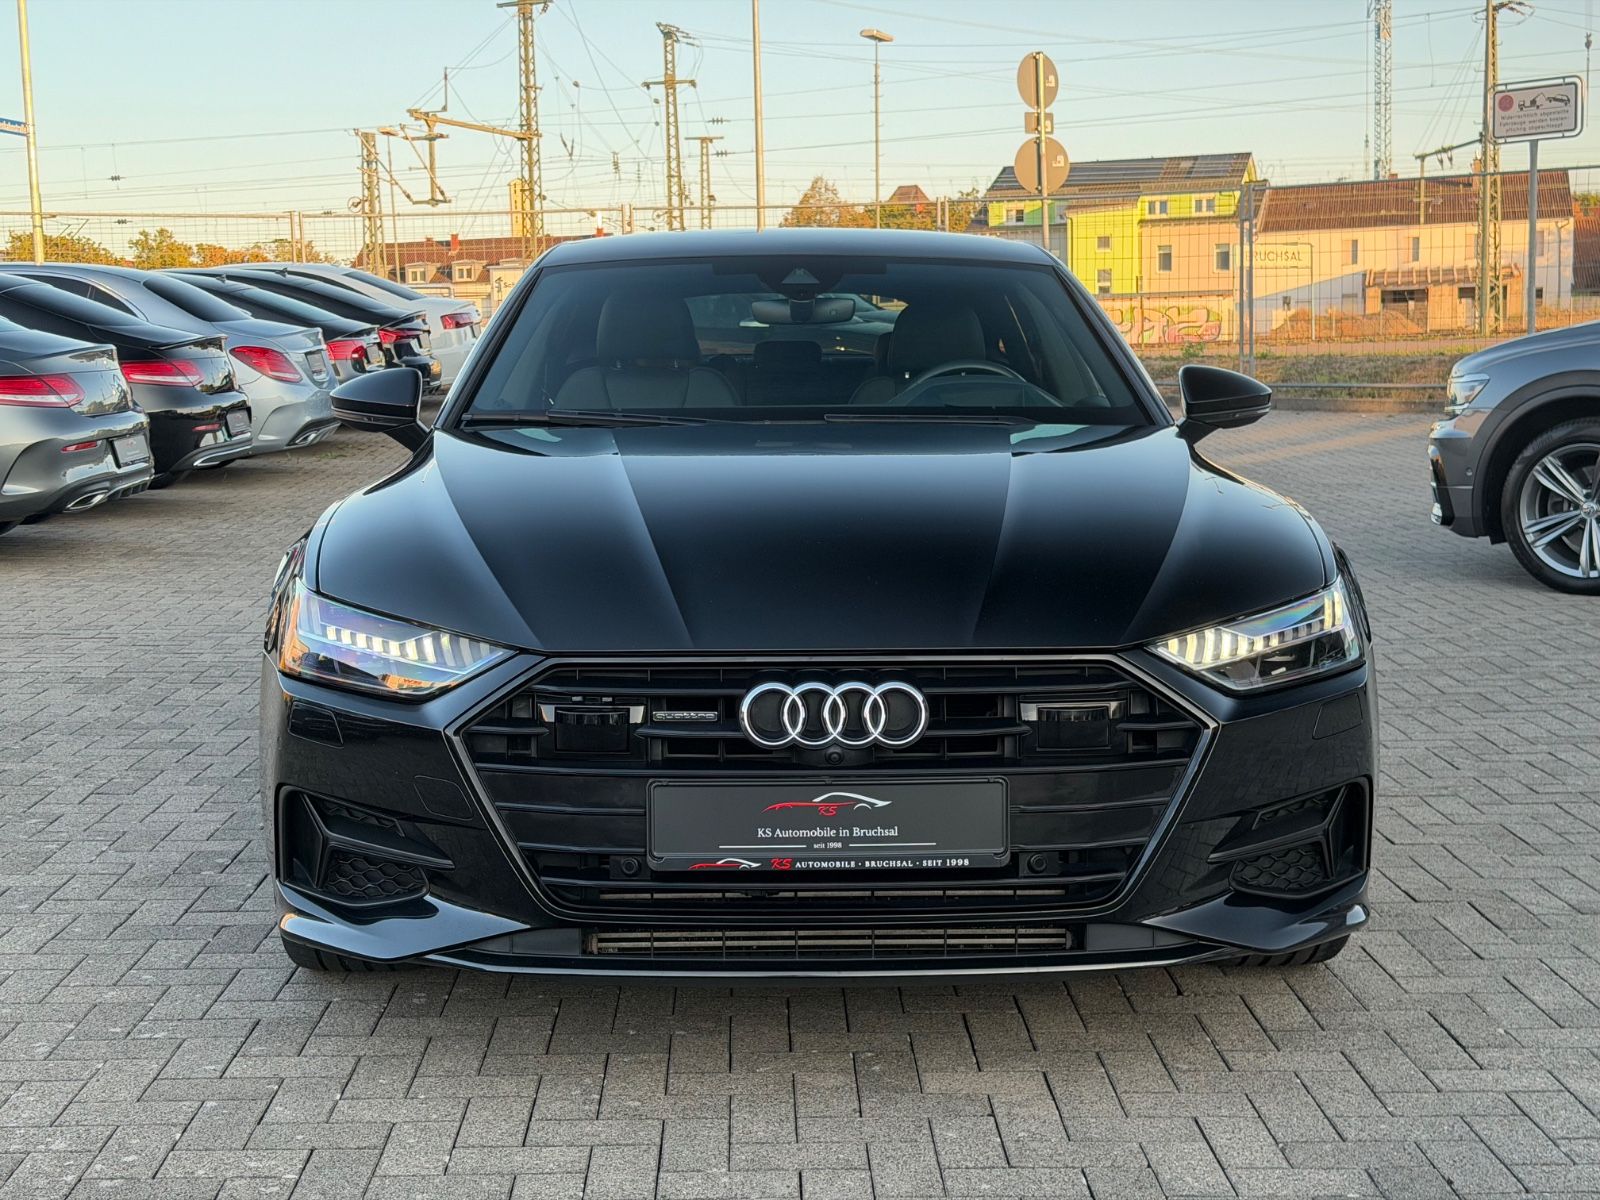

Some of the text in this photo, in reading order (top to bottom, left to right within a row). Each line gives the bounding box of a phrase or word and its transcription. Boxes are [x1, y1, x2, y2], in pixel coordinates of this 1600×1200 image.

[818, 806, 838, 816] KS
[757, 825, 899, 838] KS Automobile in Bruchsal
[771, 857, 970, 870] KS AUTOMOBILE BRUCHSAL SEIT 1998
